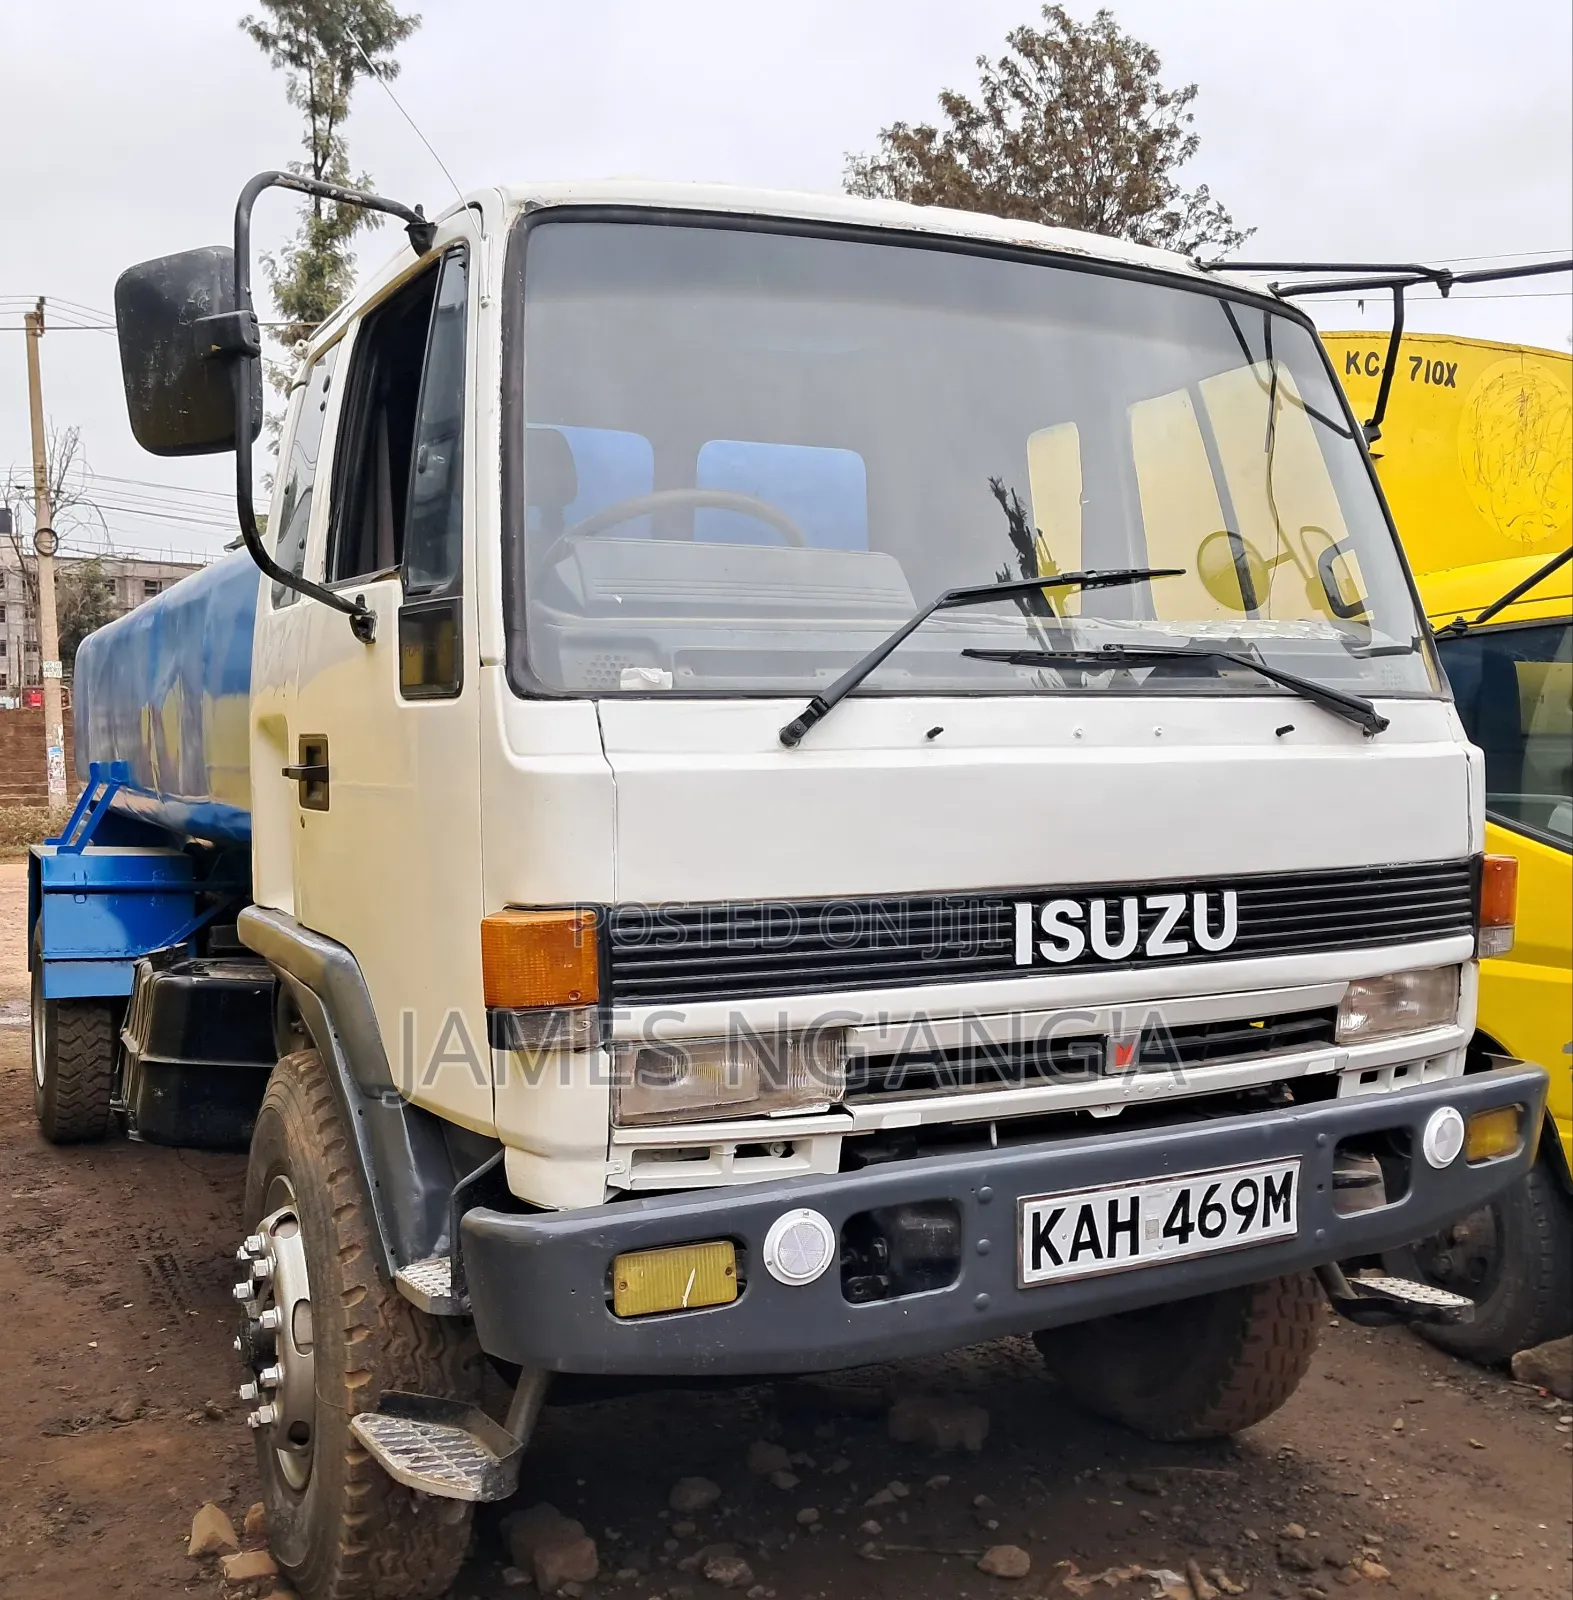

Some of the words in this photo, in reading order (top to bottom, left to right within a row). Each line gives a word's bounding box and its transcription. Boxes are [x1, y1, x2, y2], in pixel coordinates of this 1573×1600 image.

[1345, 350, 1394, 377] KC
[1408, 356, 1458, 389] 710X
[1014, 890, 1238, 966] ISUZU
[1031, 1196, 1140, 1271] KAH
[1162, 1171, 1294, 1245] 469M
